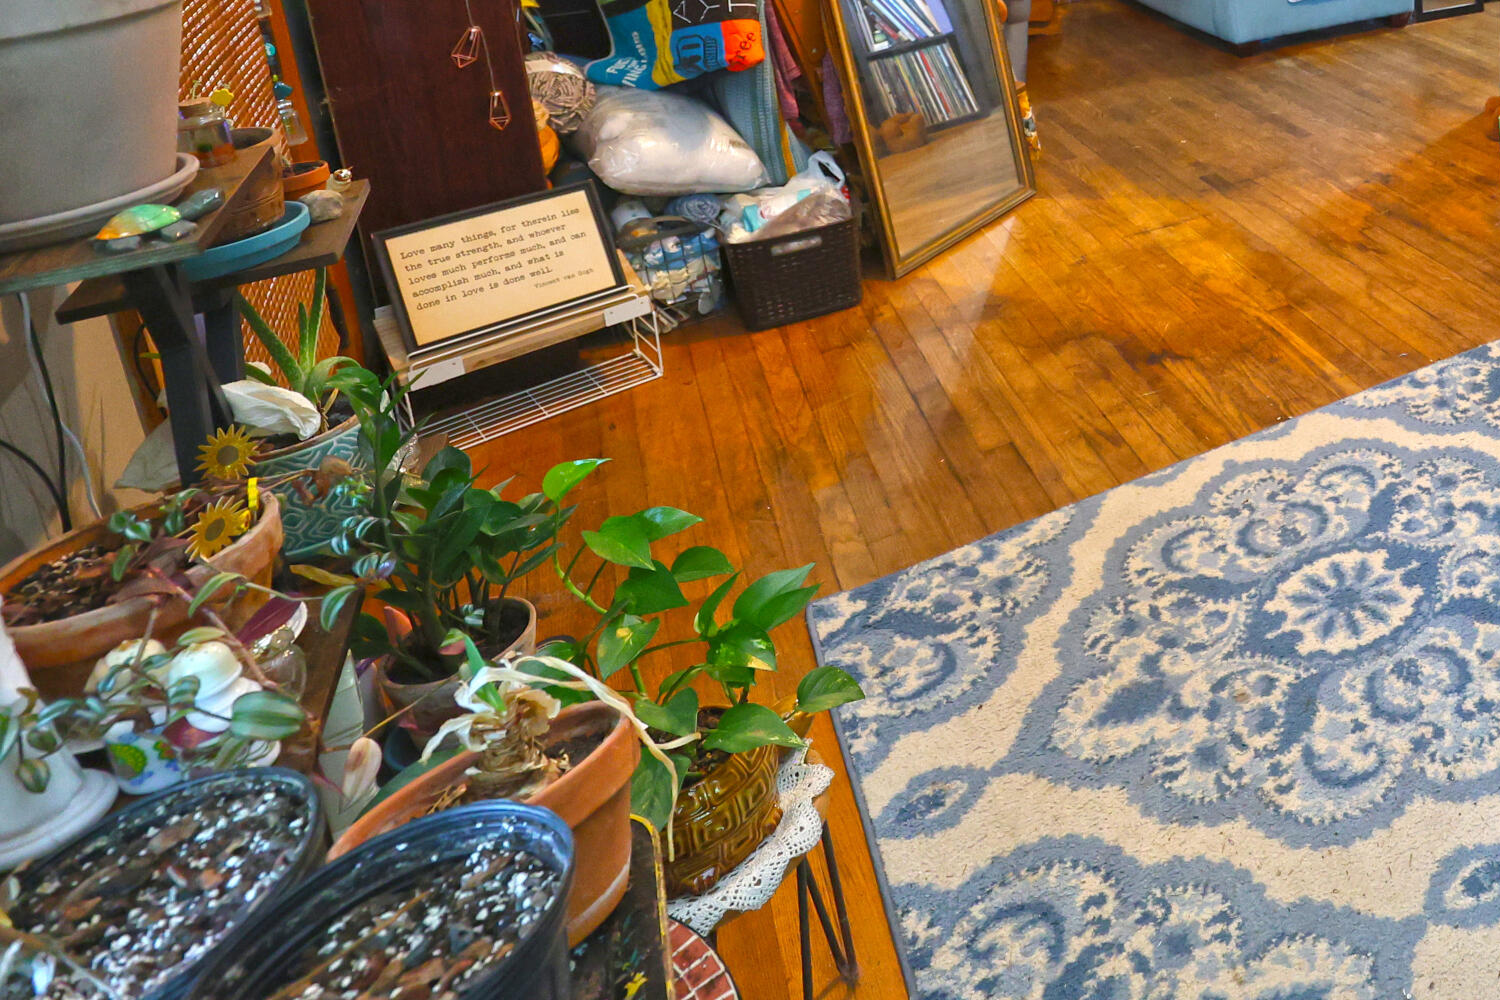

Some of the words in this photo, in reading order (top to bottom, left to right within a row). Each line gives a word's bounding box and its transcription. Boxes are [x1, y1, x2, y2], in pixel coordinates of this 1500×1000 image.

[400, 247, 425, 260] Love
[430, 240, 456, 252] many
[460, 230, 497, 245] things,
[500, 223, 517, 234] for
[521, 212, 557, 229] therein
[561, 207, 580, 218] lies
[404, 261, 423, 272] the
[427, 254, 451, 265] true
[455, 241, 503, 259] strength,
[506, 233, 525, 245] and
[528, 223, 566, 239] whoever
[408, 274, 438, 285] loves
[441, 263, 467, 276] much
[471, 250, 516, 269] performs
[519, 242, 546, 256] much,
[549, 235, 567, 247] and
[570, 230, 587, 241] can
[411, 277, 470, 297] accomplish
[474, 269, 501, 282] much,
[504, 260, 523, 272] and
[527, 253, 551, 265] what
[554, 249, 565, 258] is
[416, 298, 441, 311] done
[445, 292, 457, 302] in
[462, 285, 484, 298] love
[489, 281, 499, 291] is
[503, 273, 526, 286] done
[529, 266, 553, 279] well.
